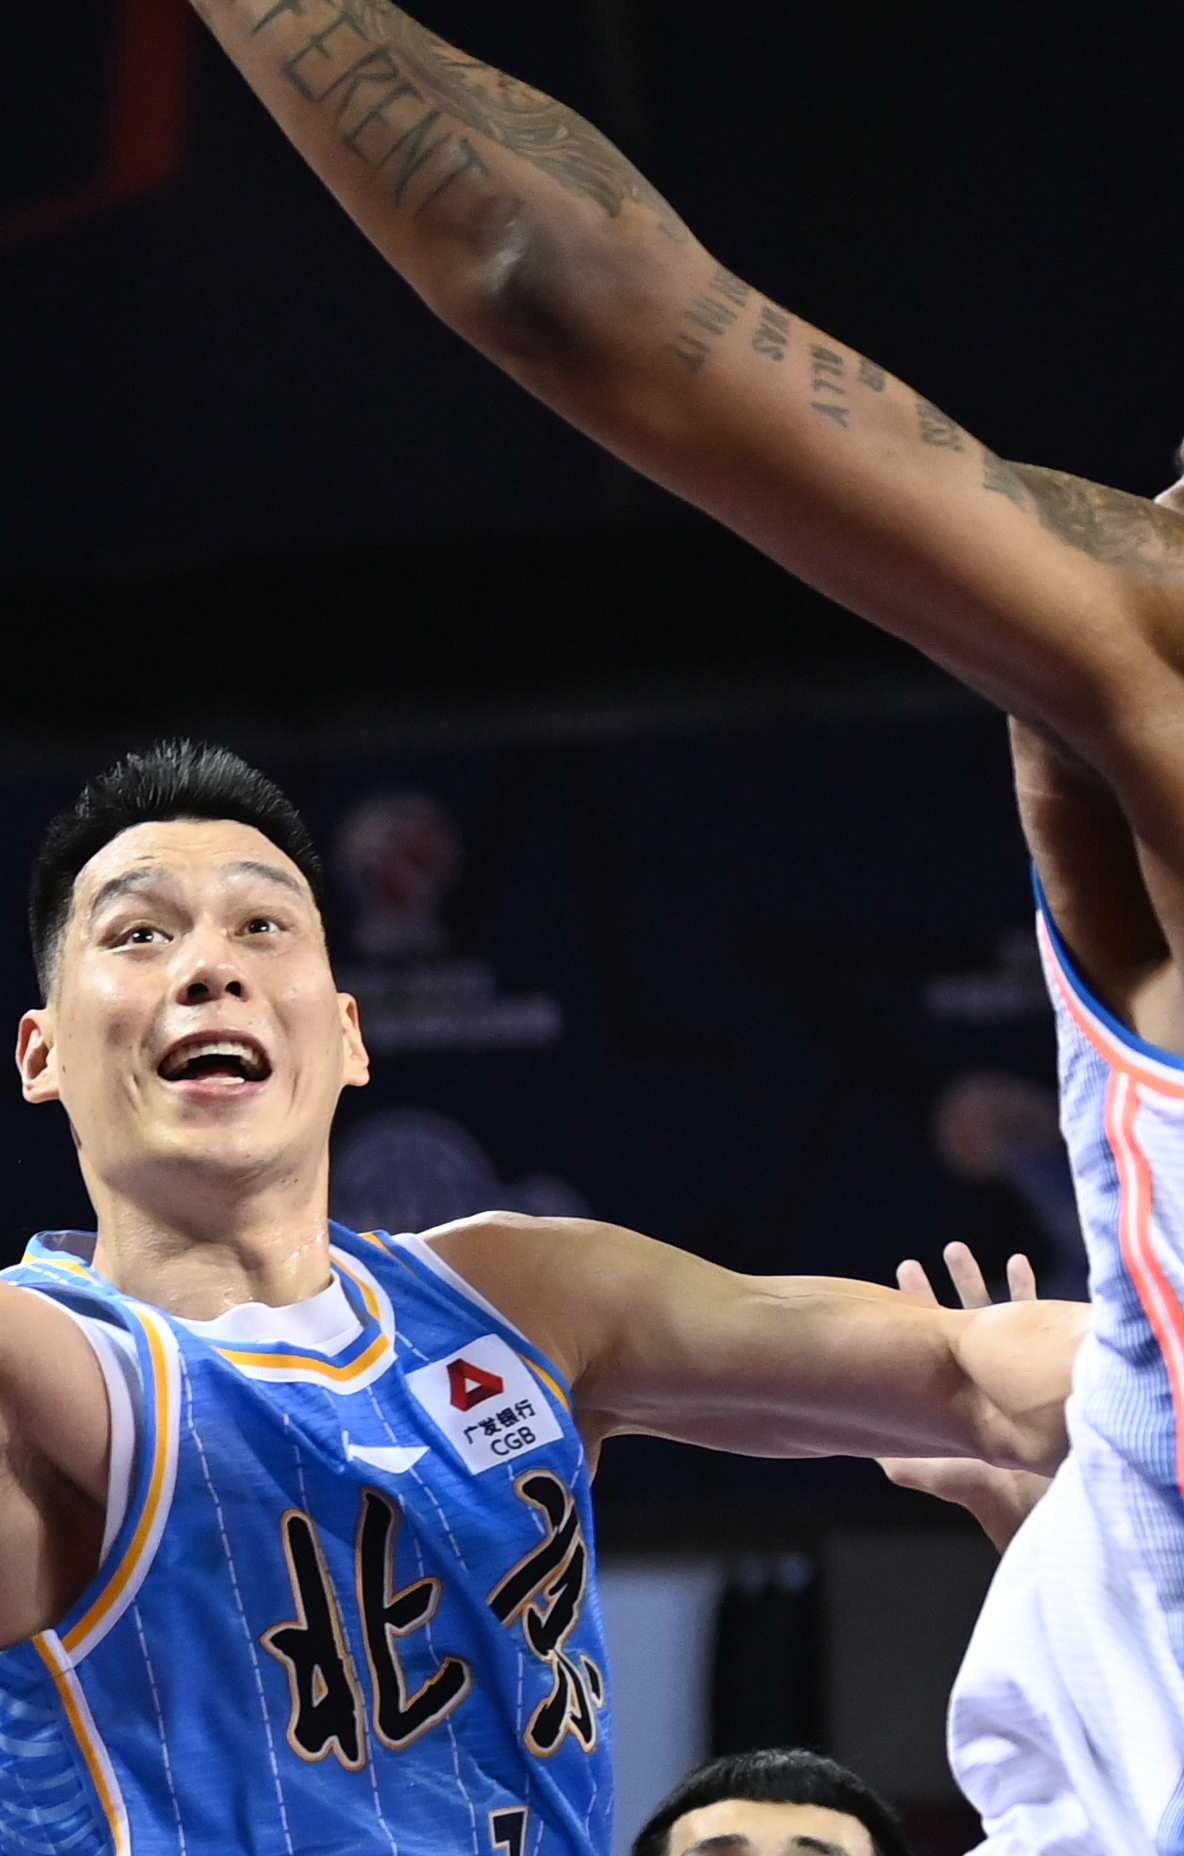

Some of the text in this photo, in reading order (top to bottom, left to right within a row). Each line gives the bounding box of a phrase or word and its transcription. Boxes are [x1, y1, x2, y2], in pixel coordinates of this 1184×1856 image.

[463, 1399, 536, 1444] 广发银行
[490, 1426, 536, 1456] CGB
[259, 1469, 605, 1772] 北京
